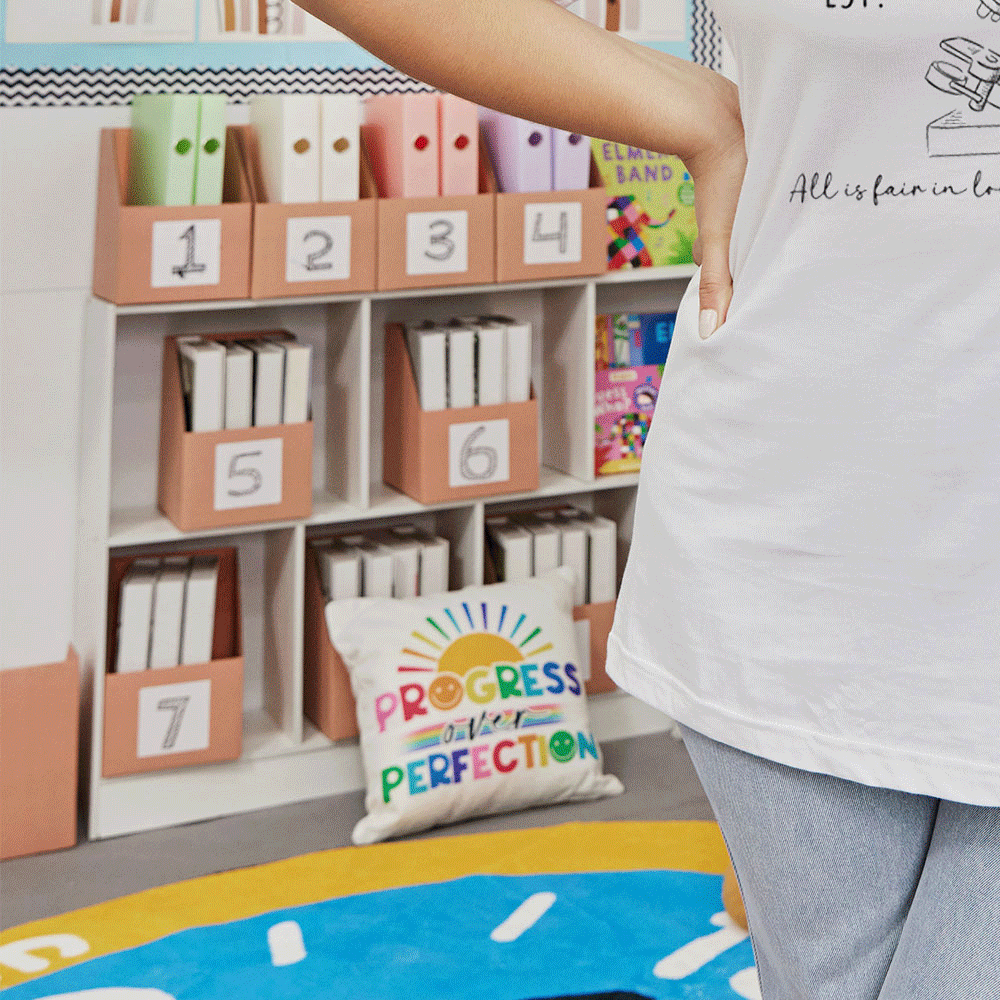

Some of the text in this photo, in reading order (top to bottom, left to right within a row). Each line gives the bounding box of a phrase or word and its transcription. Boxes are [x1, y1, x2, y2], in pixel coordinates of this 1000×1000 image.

[616, 165, 673, 185] BAND
[789, 171, 839, 204] All
[844, 183, 867, 201] is
[872, 174, 927, 206] fair
[932, 182, 967, 196] in
[172, 224, 207, 279] 1
[303, 229, 333, 271] 2
[424, 219, 456, 261] 3
[531, 211, 568, 253] 4
[227, 449, 263, 497] 5
[458, 425, 498, 481] 6
[374, 662, 582, 733] PROGRESS
[156, 696, 191, 750] 7
[443, 708, 529, 743] over
[381, 730, 599, 804] PERFECTION
